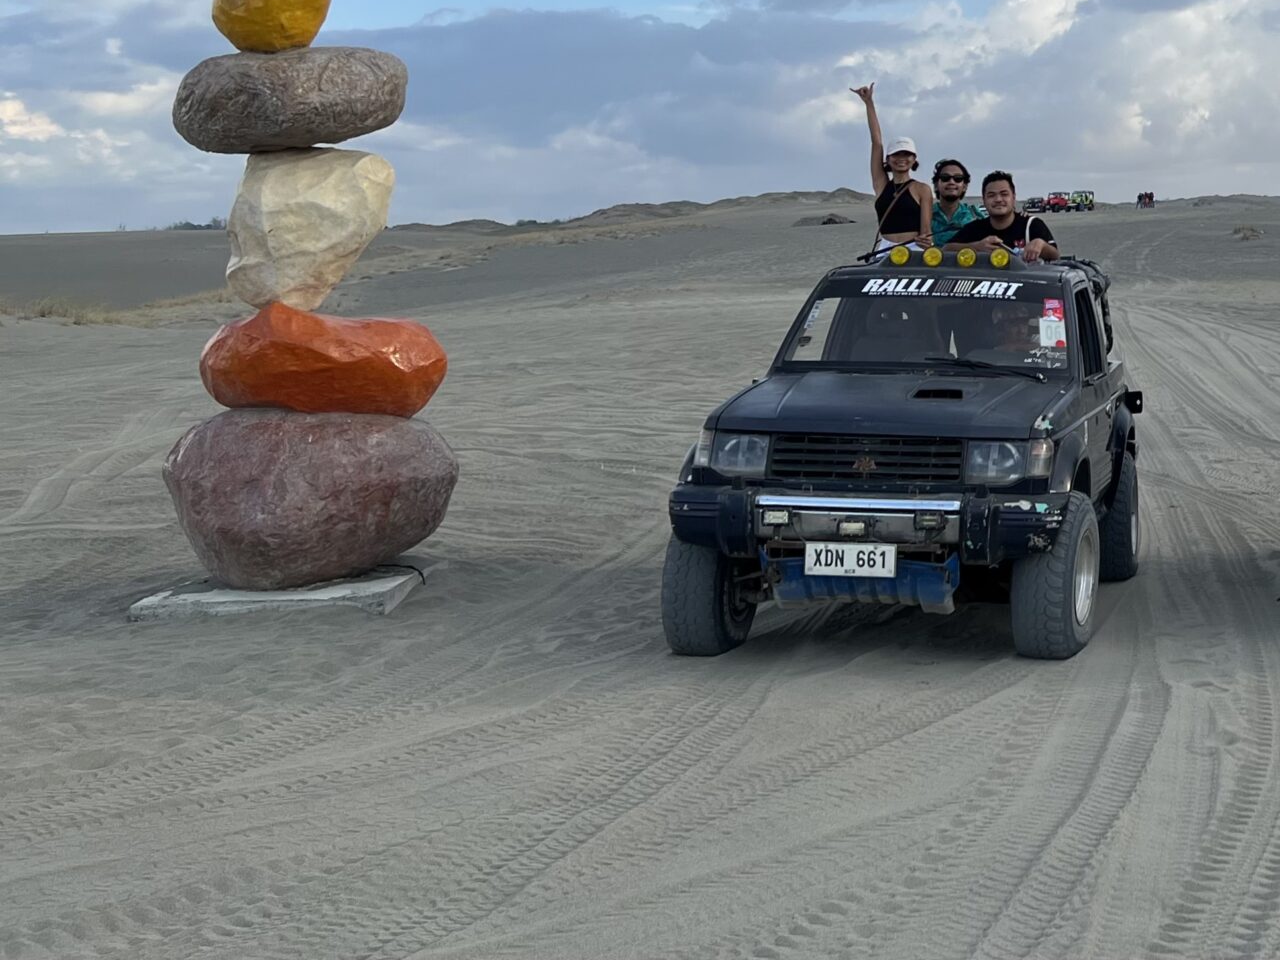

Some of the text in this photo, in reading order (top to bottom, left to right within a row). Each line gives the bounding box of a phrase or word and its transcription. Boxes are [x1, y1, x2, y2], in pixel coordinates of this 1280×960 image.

[861, 278, 1024, 296] RALLI ART
[813, 548, 886, 569] XDN 661
